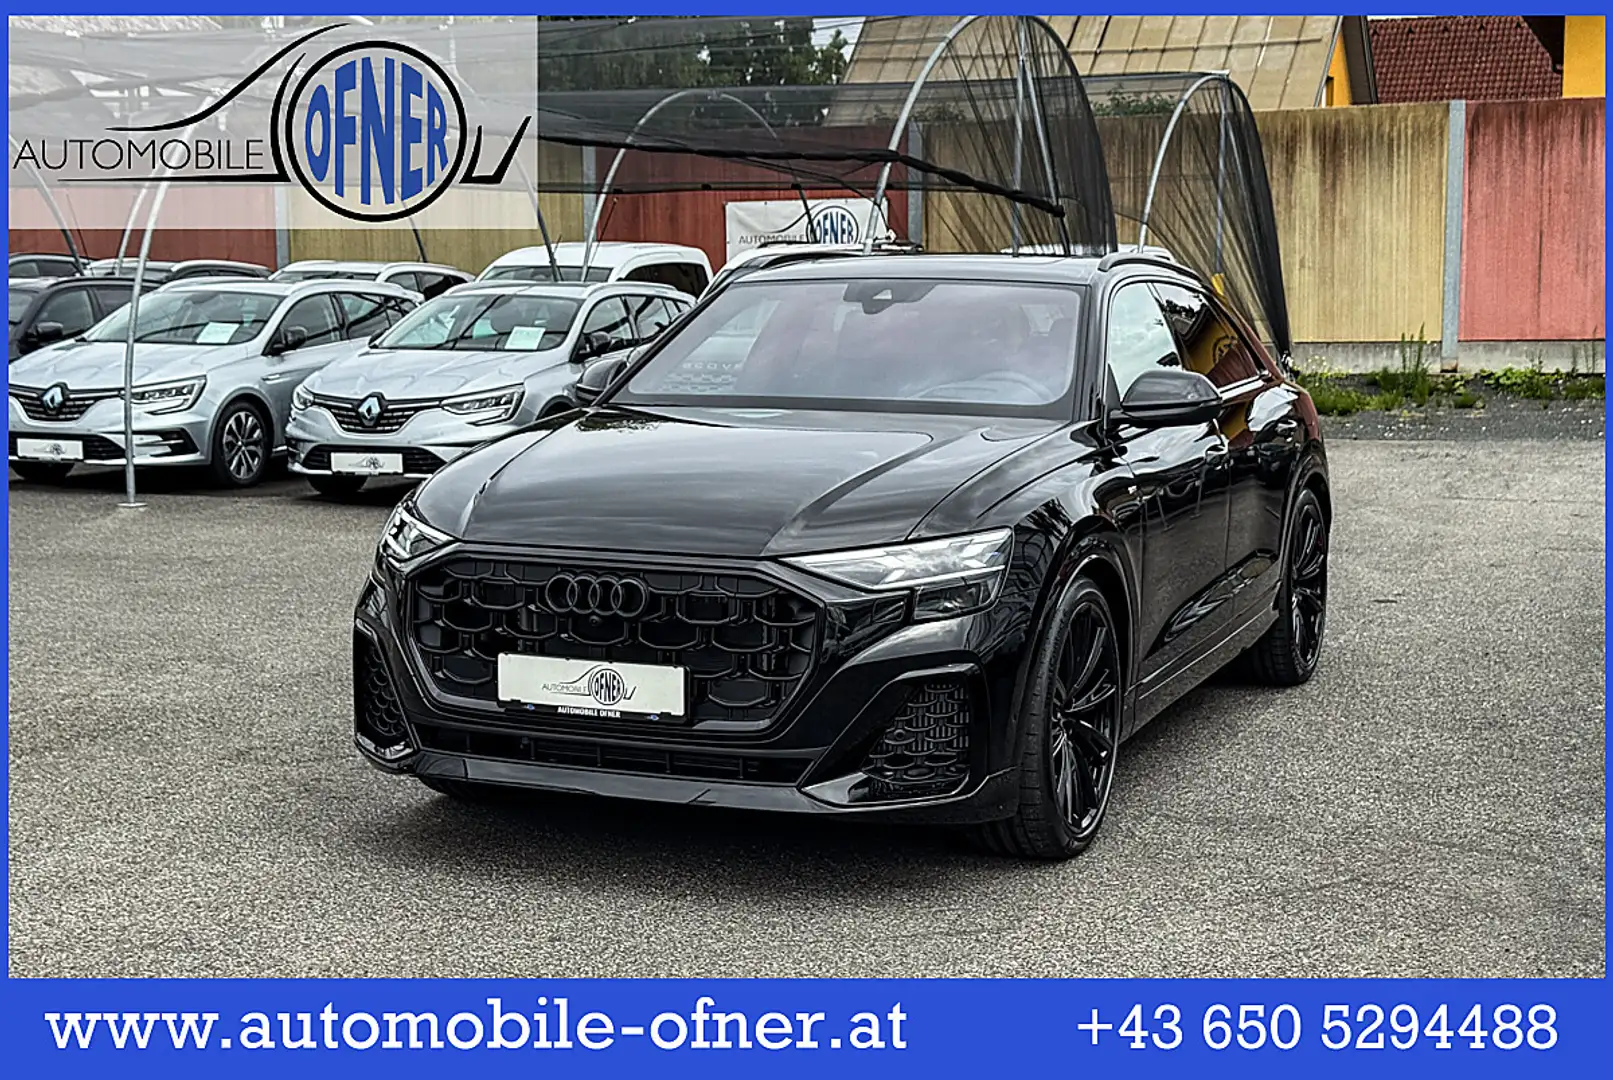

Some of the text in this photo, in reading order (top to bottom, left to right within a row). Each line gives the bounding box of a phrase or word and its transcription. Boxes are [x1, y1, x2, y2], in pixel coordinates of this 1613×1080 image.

[541, 671, 621, 702] AUTOMOBILE OFNER
[557, 706, 621, 718] AUTOMOBILE OFNER
